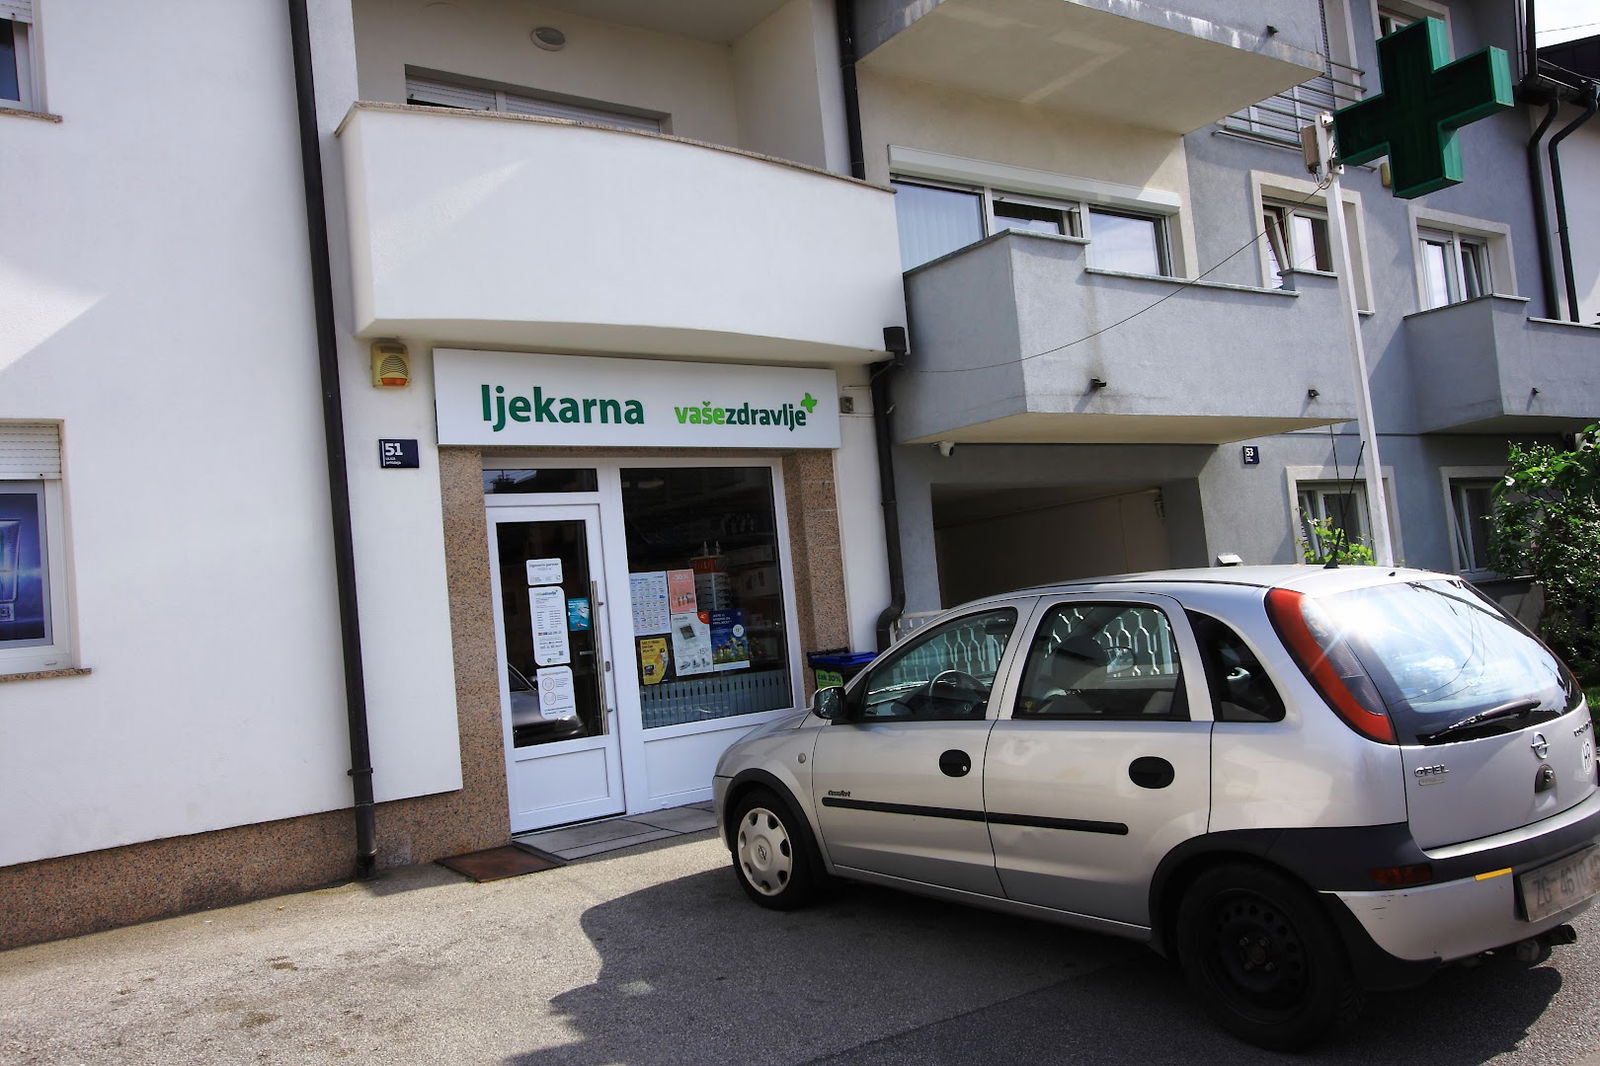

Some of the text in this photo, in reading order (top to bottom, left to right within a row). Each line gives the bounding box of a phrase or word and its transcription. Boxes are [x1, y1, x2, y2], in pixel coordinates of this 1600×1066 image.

[481, 385, 807, 432] ljekarna vašezdravlje
[385, 442, 403, 456] 51
[1246, 447, 1254, 457] 53
[1414, 764, 1450, 777] OPEL
